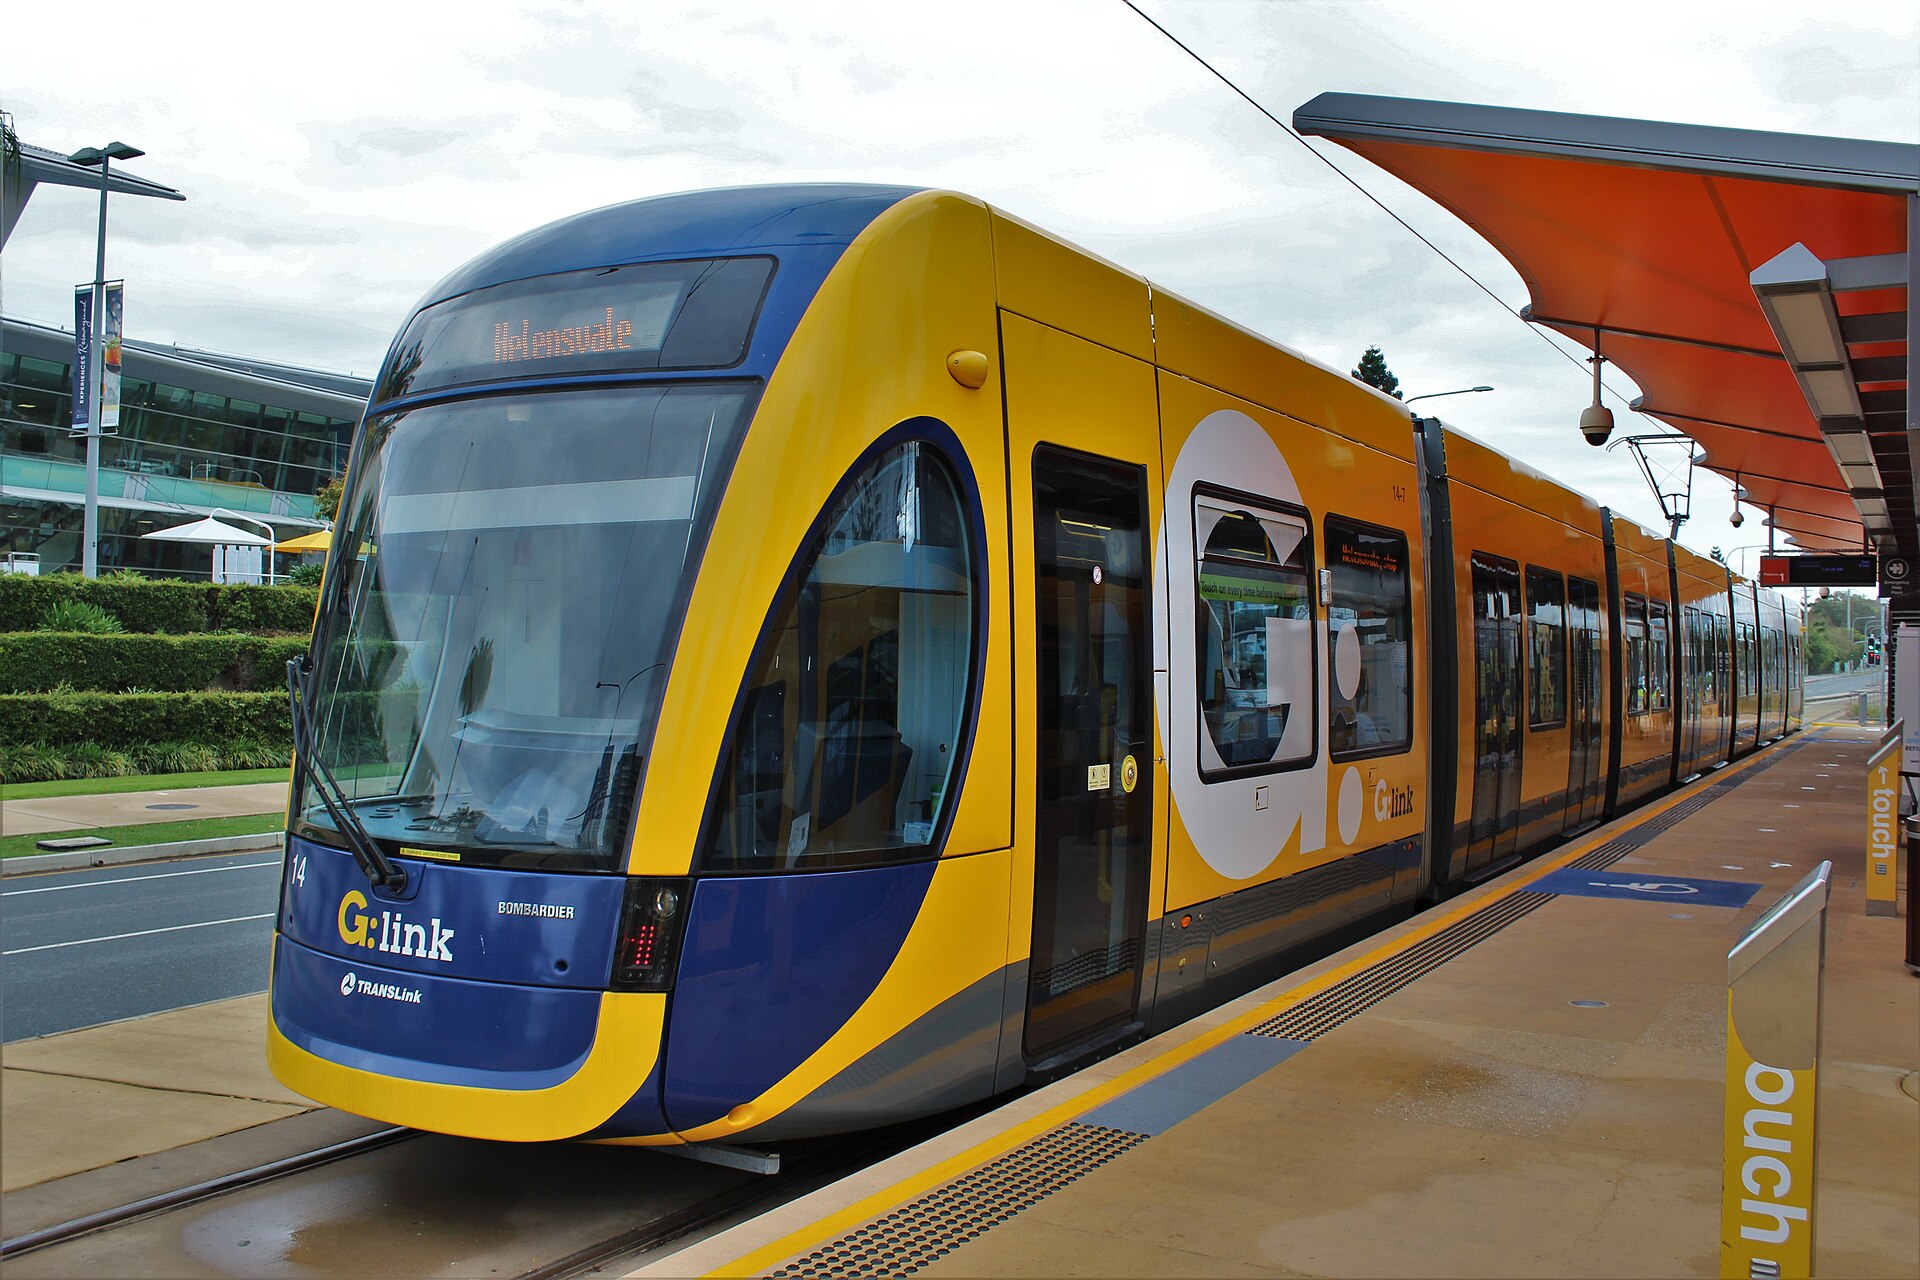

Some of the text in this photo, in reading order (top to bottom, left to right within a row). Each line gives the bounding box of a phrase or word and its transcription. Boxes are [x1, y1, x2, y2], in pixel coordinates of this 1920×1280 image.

[77, 299, 91, 355] Reimagined
[494, 306, 632, 364] Helensvale
[1392, 485, 1406, 504] 14-7
[1201, 581, 1218, 594] Touch
[1219, 586, 1227, 594] on
[1227, 587, 1242, 599] every
[1243, 585, 1255, 597] time
[1256, 586, 1273, 599] before
[1273, 591, 1283, 602] you
[1374, 778, 1414, 823] G:link
[1872, 787, 1896, 858] touch
[292, 853, 306, 888] 14
[337, 889, 455, 962] G:link
[498, 901, 575, 920] BOMBARDIER
[357, 978, 422, 1004] TRANSLink
